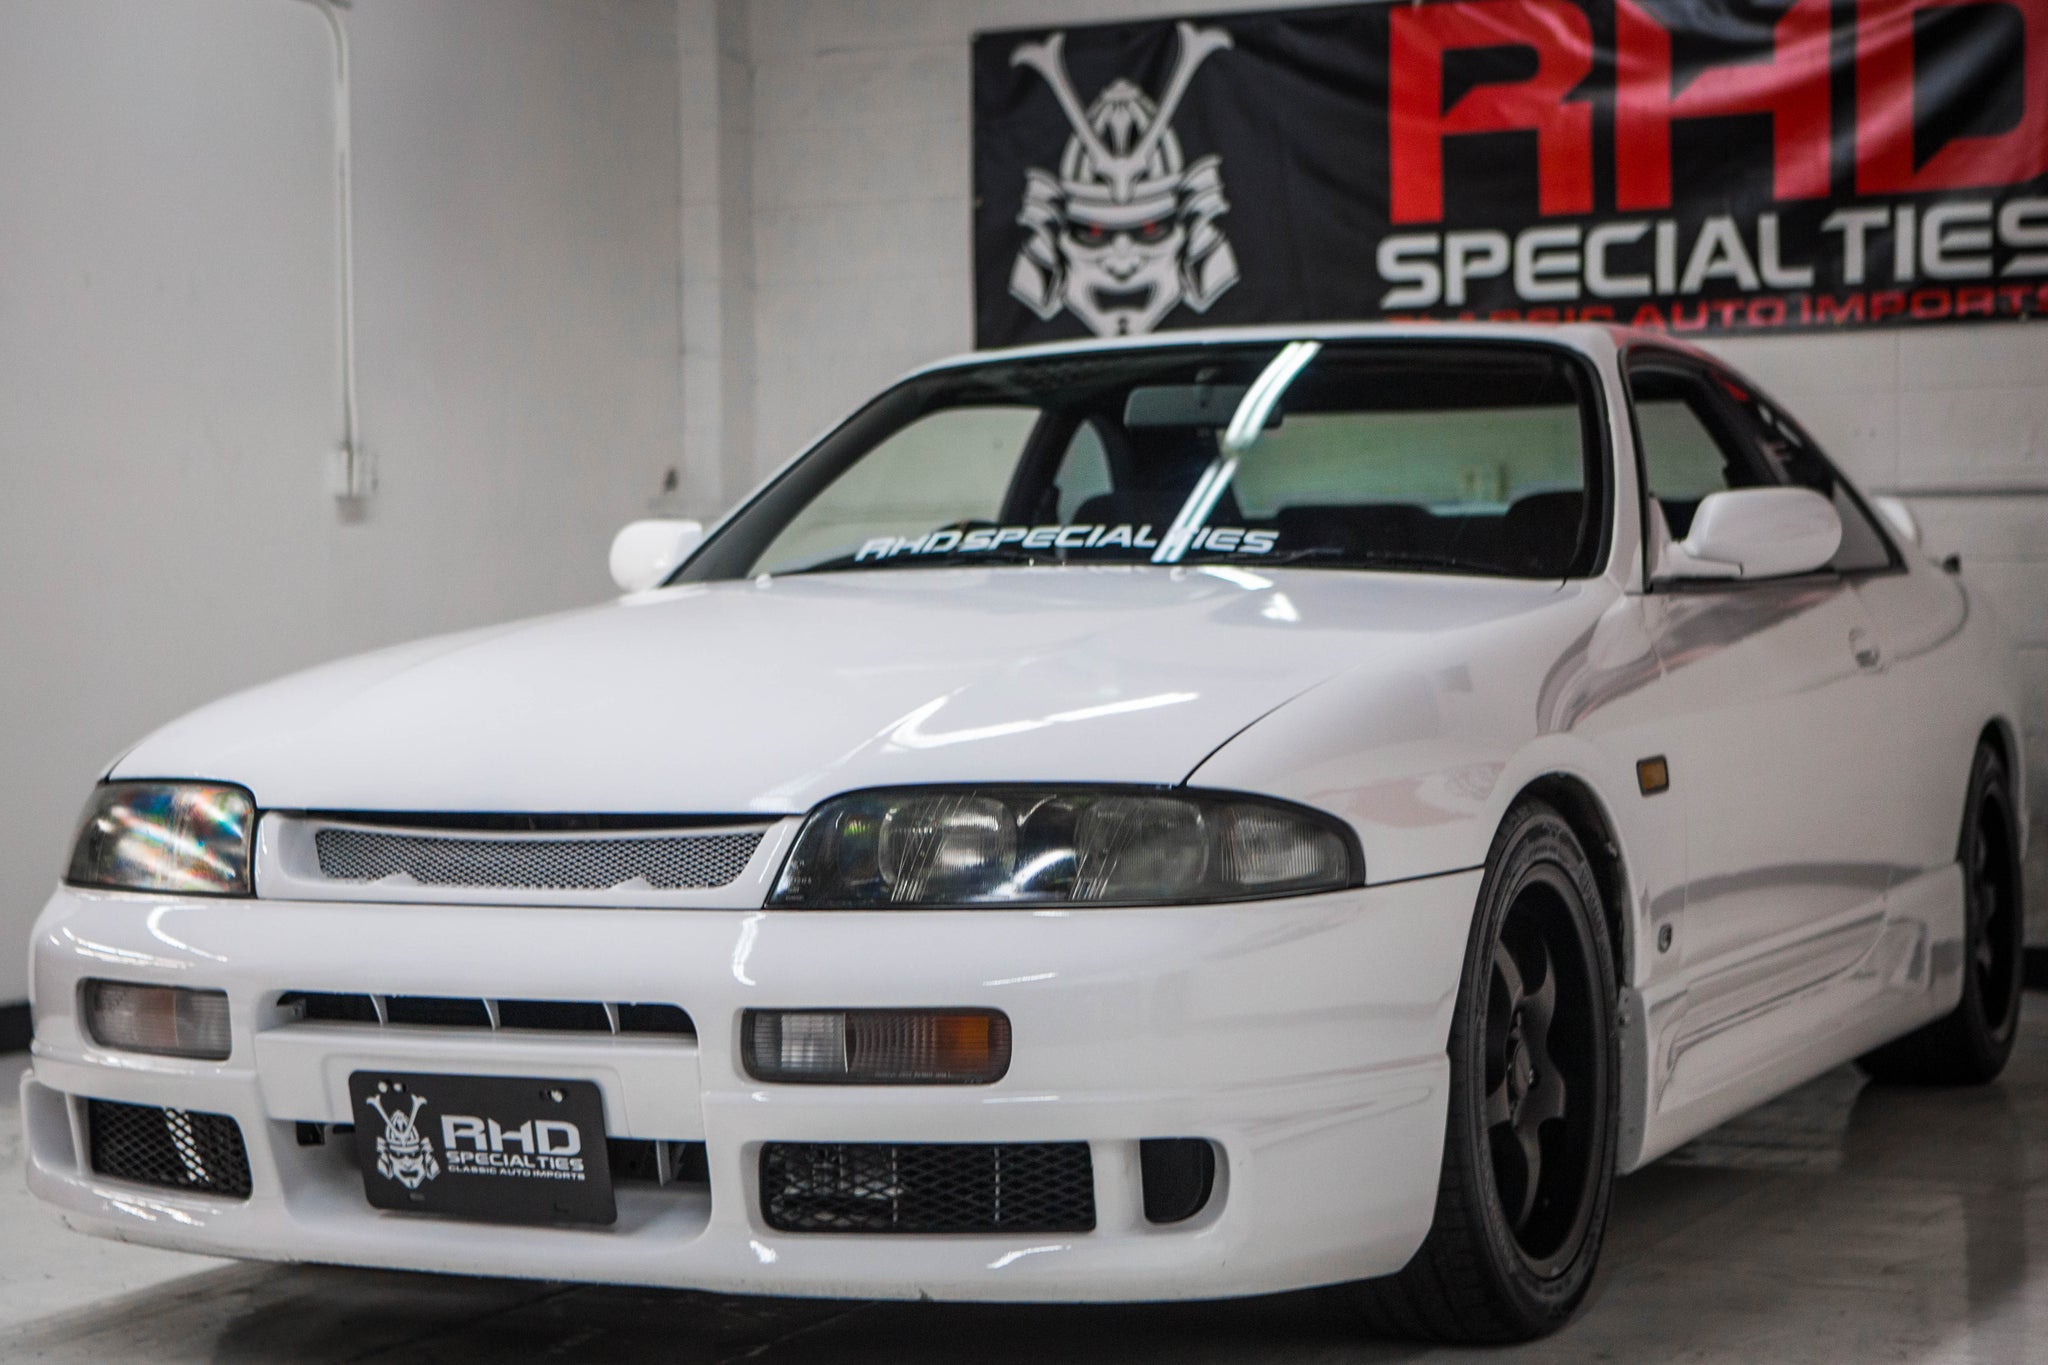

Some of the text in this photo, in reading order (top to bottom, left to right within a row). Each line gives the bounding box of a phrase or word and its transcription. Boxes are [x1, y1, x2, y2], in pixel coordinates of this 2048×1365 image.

[1390, 0, 2048, 224] RHD
[1631, 296, 1787, 330] AUTO
[1800, 284, 2048, 326] IMPORT
[440, 1114, 582, 1157] RHD
[446, 1151, 585, 1172] SPECIALTIES
[449, 1165, 586, 1181] CLASSIC AUTO IMPORTS
